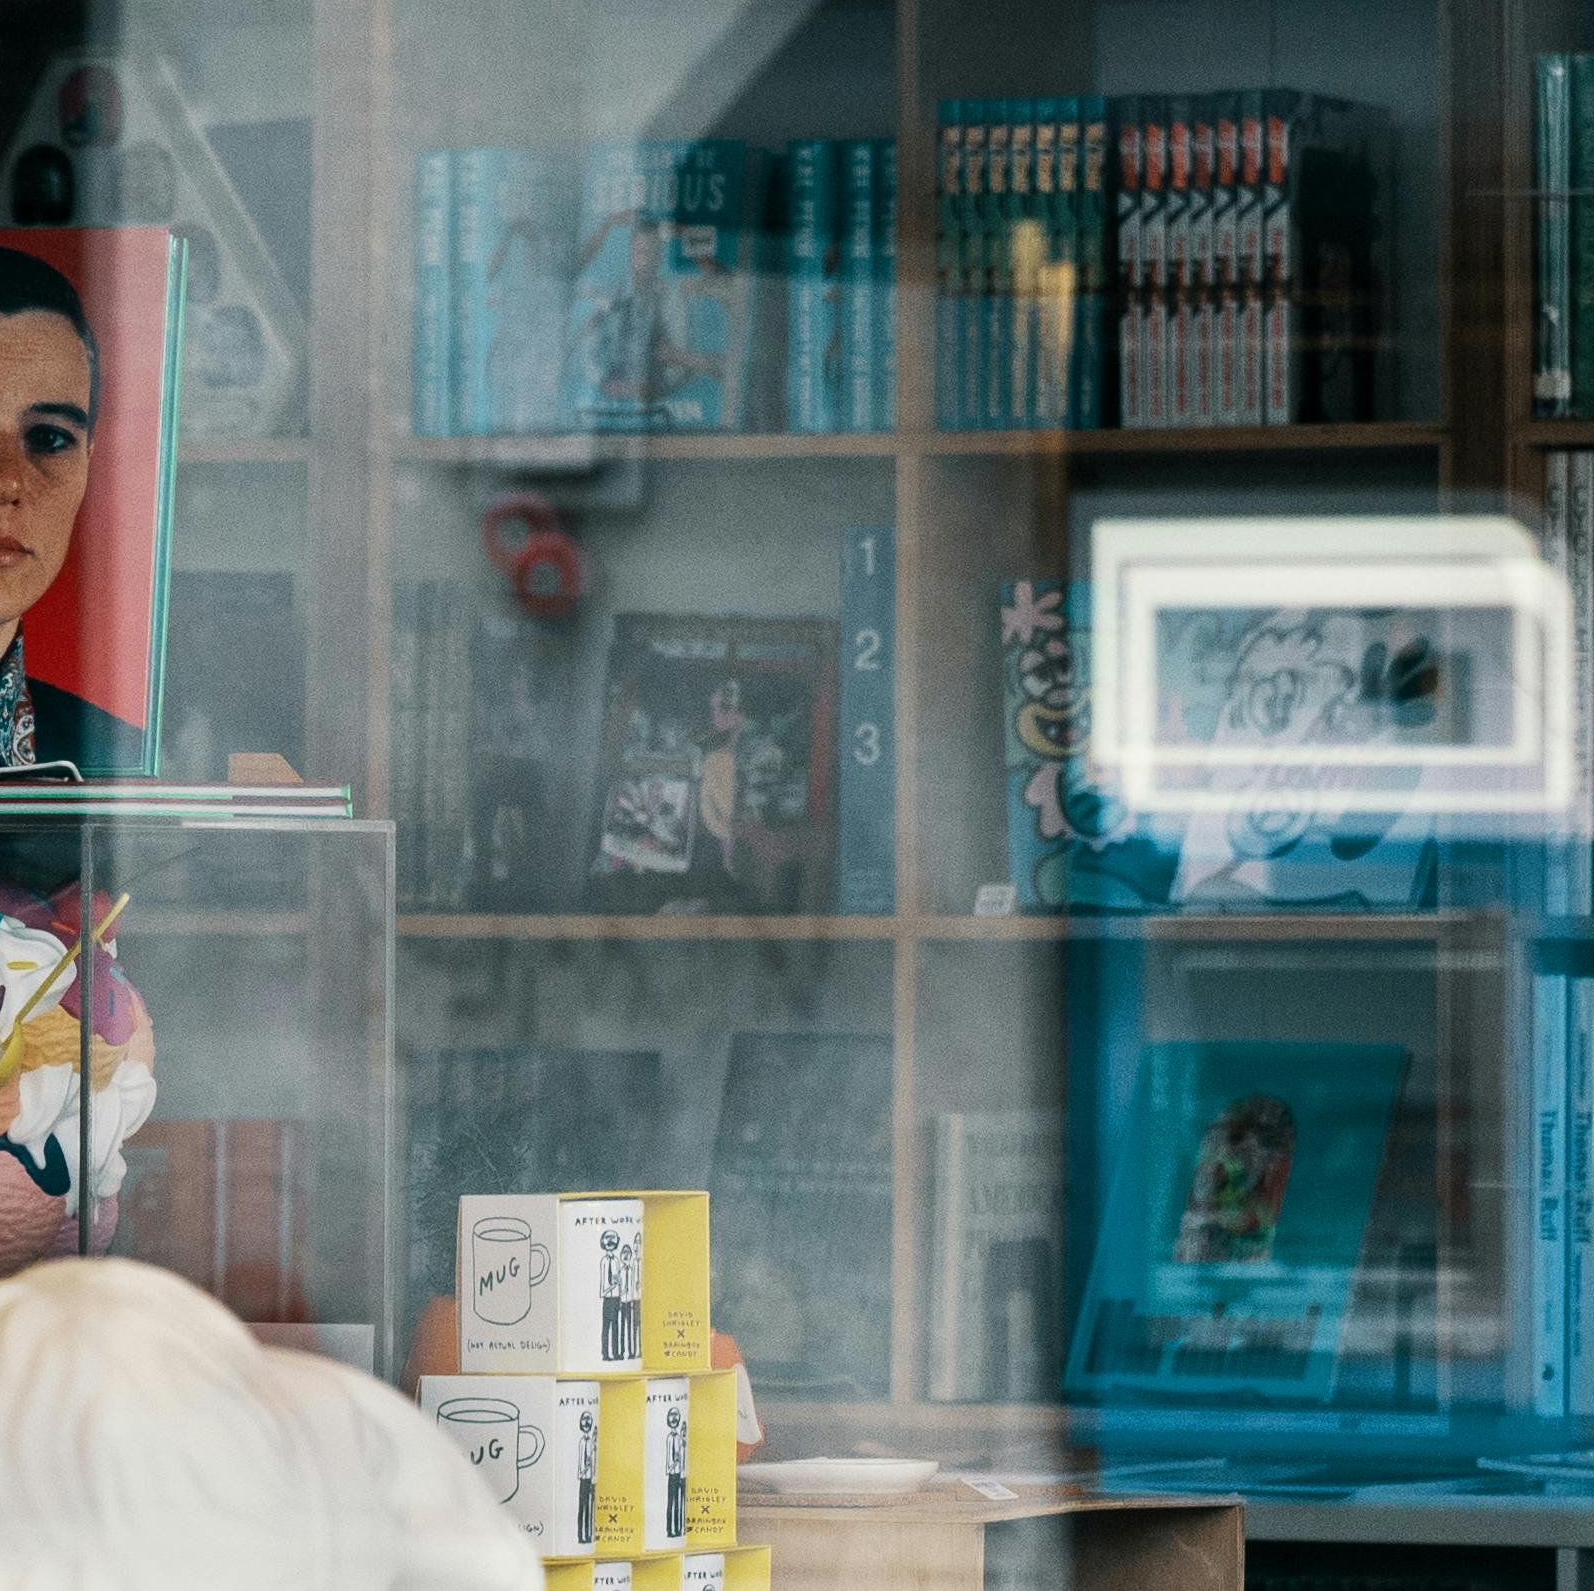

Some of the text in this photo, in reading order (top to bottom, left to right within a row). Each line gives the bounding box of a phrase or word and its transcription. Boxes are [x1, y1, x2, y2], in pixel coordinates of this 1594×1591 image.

[857, 536, 878, 576] 1
[855, 629, 881, 672] 2
[853, 724, 881, 766] 3
[574, 1216, 634, 1227] AFTER WORK
[479, 1256, 521, 1297] MUG
[559, 1397, 584, 1407] AFTER
[646, 1394, 672, 1404] AFTER
[470, 1438, 504, 1465] UG
[686, 1495, 726, 1503] HRIGLEY
